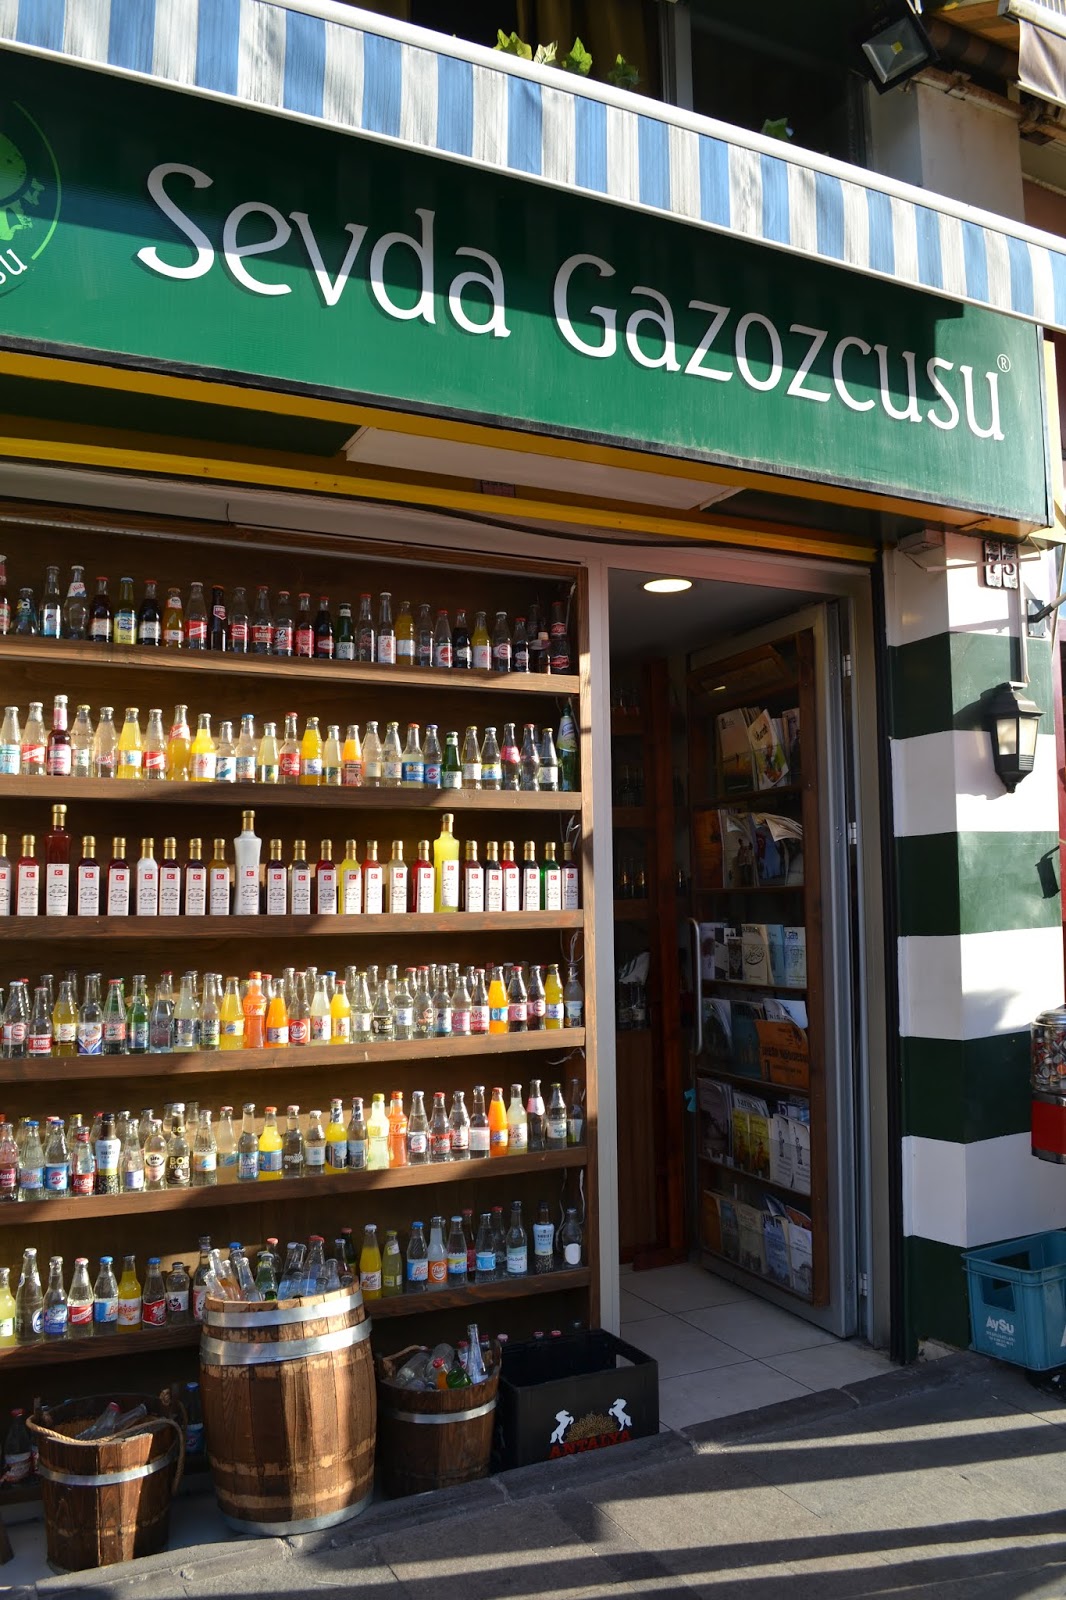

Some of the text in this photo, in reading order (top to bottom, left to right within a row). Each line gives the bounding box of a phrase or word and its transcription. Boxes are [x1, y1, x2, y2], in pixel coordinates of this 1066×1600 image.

[135, 161, 511, 338] Sevda
[553, 253, 1006, 443] Gazozcusu
[985, 1315, 1015, 1334] AySu
[548, 1430, 631, 1459] ANTALYA
